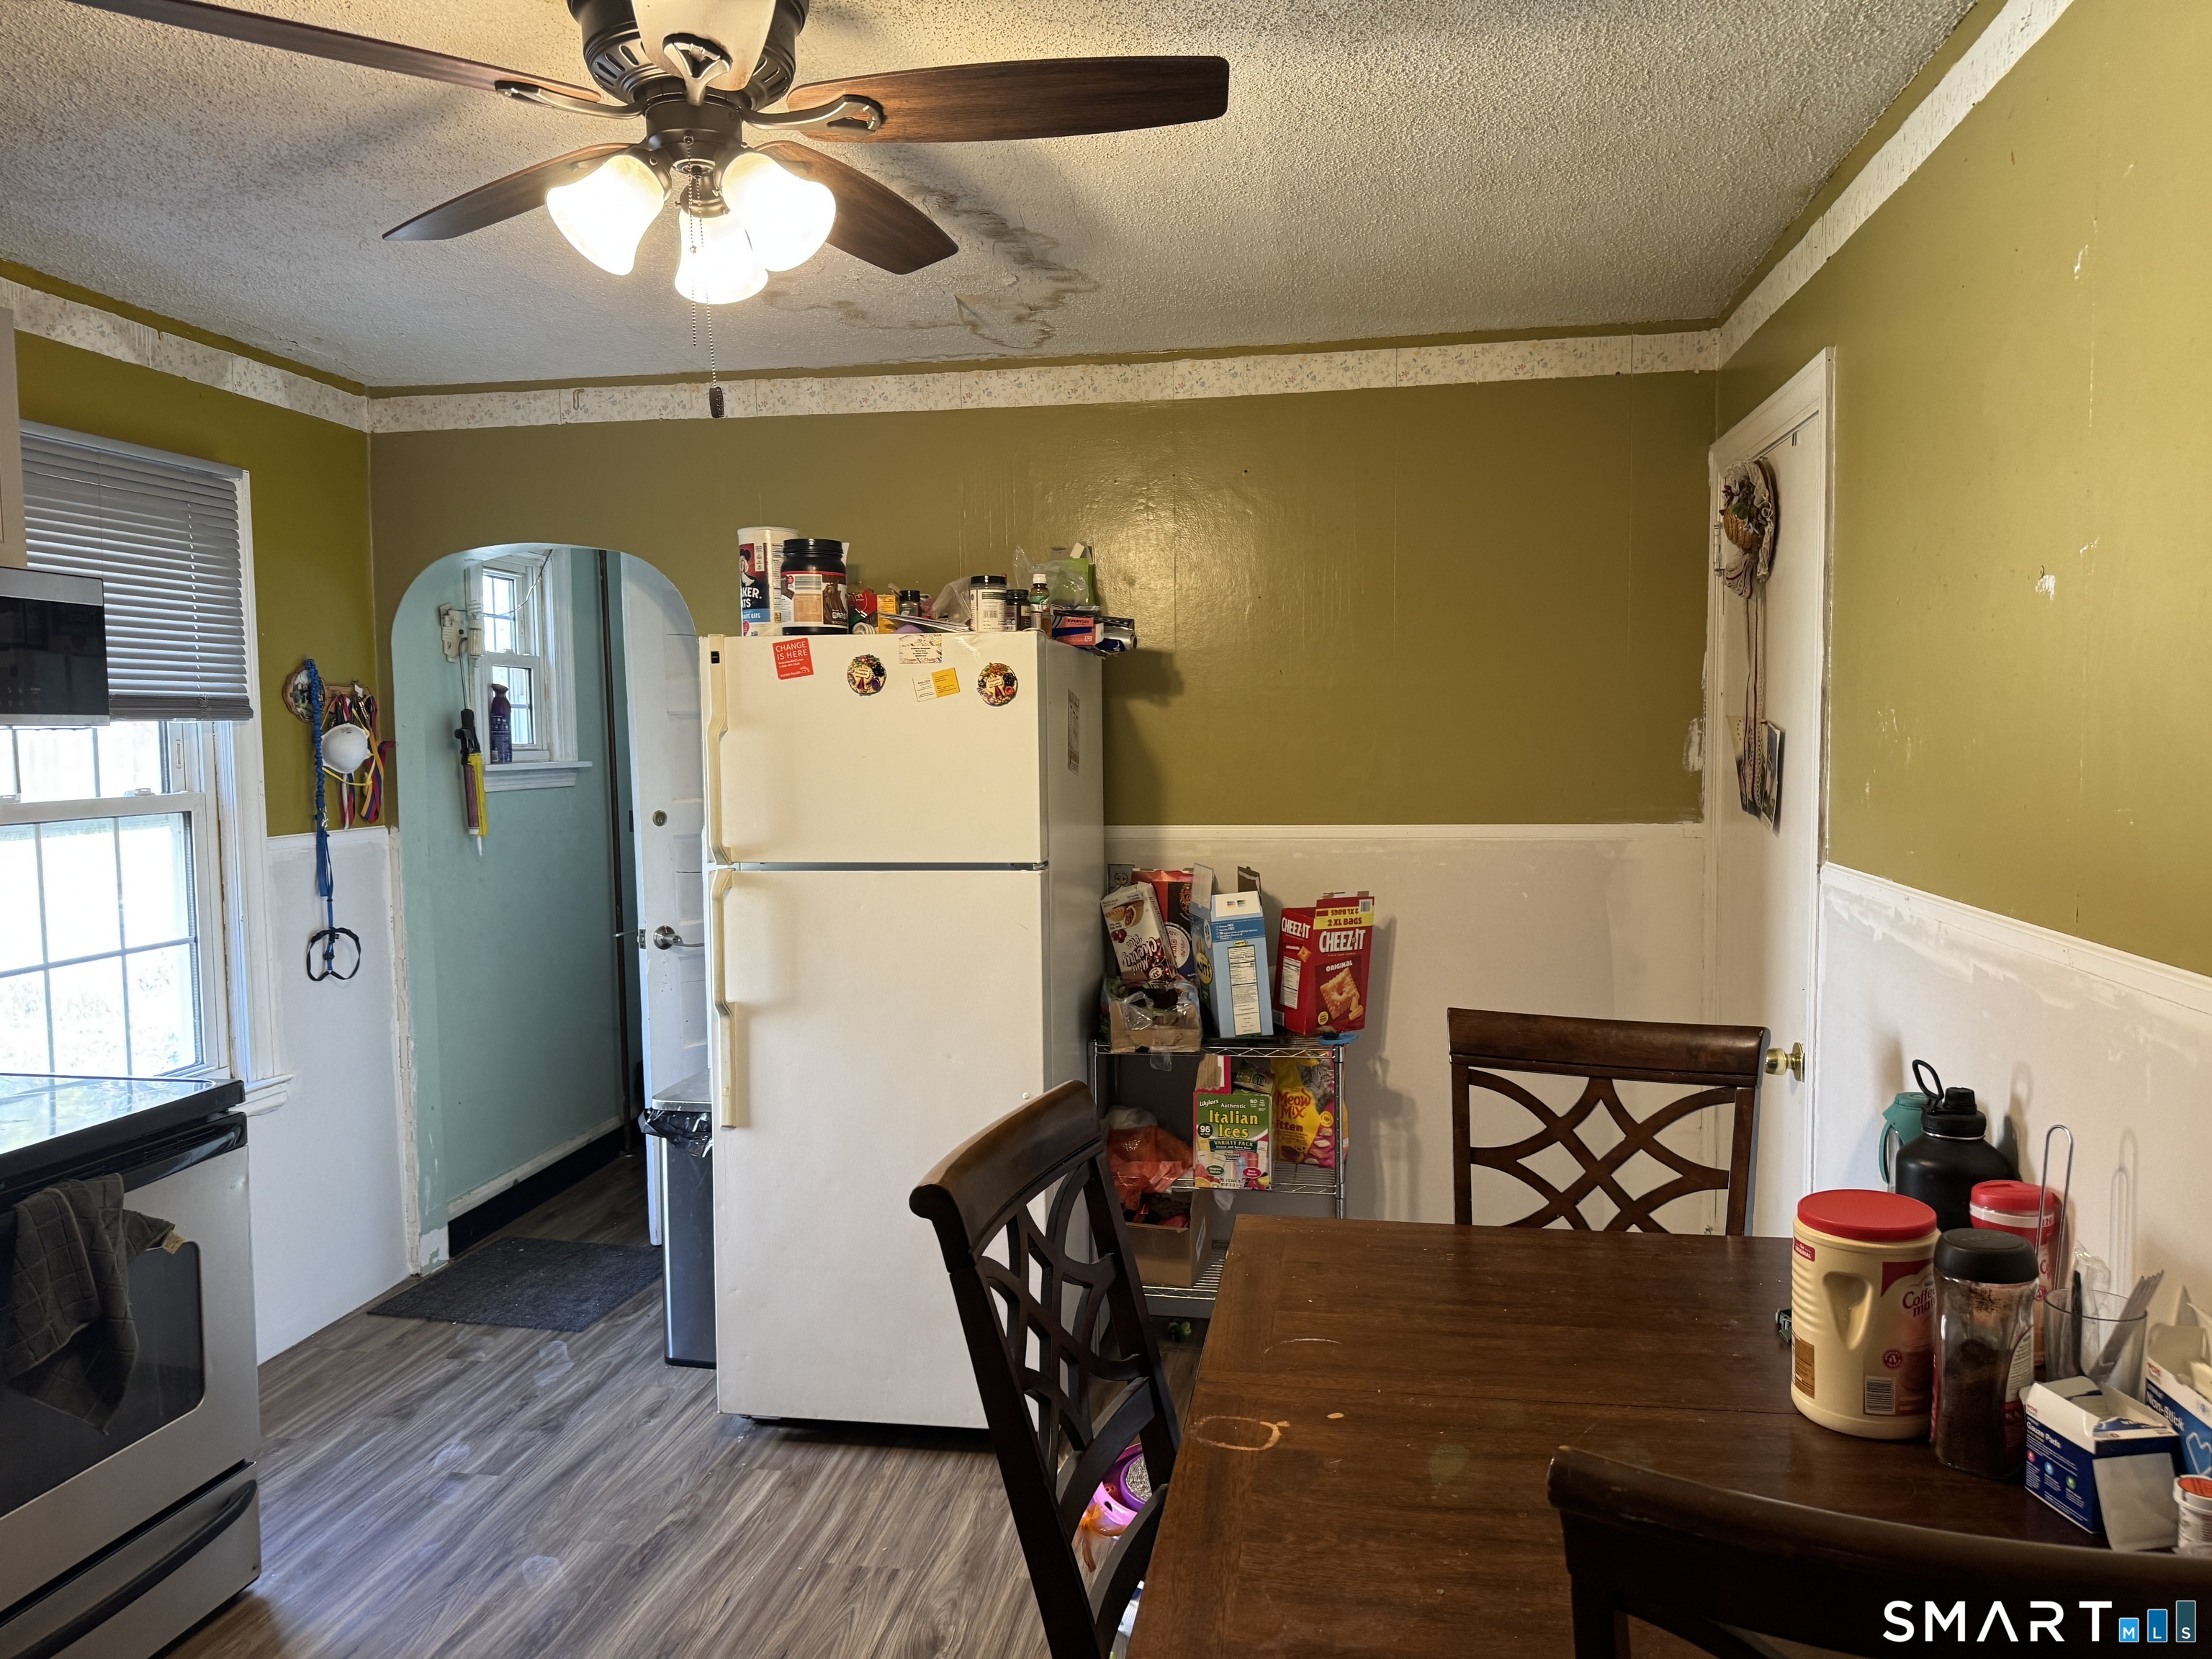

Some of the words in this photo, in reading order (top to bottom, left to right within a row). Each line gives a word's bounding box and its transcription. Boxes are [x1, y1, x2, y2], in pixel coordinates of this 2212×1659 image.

[775, 641, 806, 652] CHANGE
[786, 649, 808, 659] HERE
[1122, 937, 1157, 967] Cherry
[1277, 1088, 1311, 1107] Meow
[1209, 1110, 1259, 1125] Italian
[1218, 1124, 1249, 1138] Ices
[1277, 1120, 1303, 1133] itten
[2146, 1391, 2185, 1431] Non-Stick
[2027, 1422, 2044, 1437] Gauze
[2045, 1433, 2062, 1449] Pads
